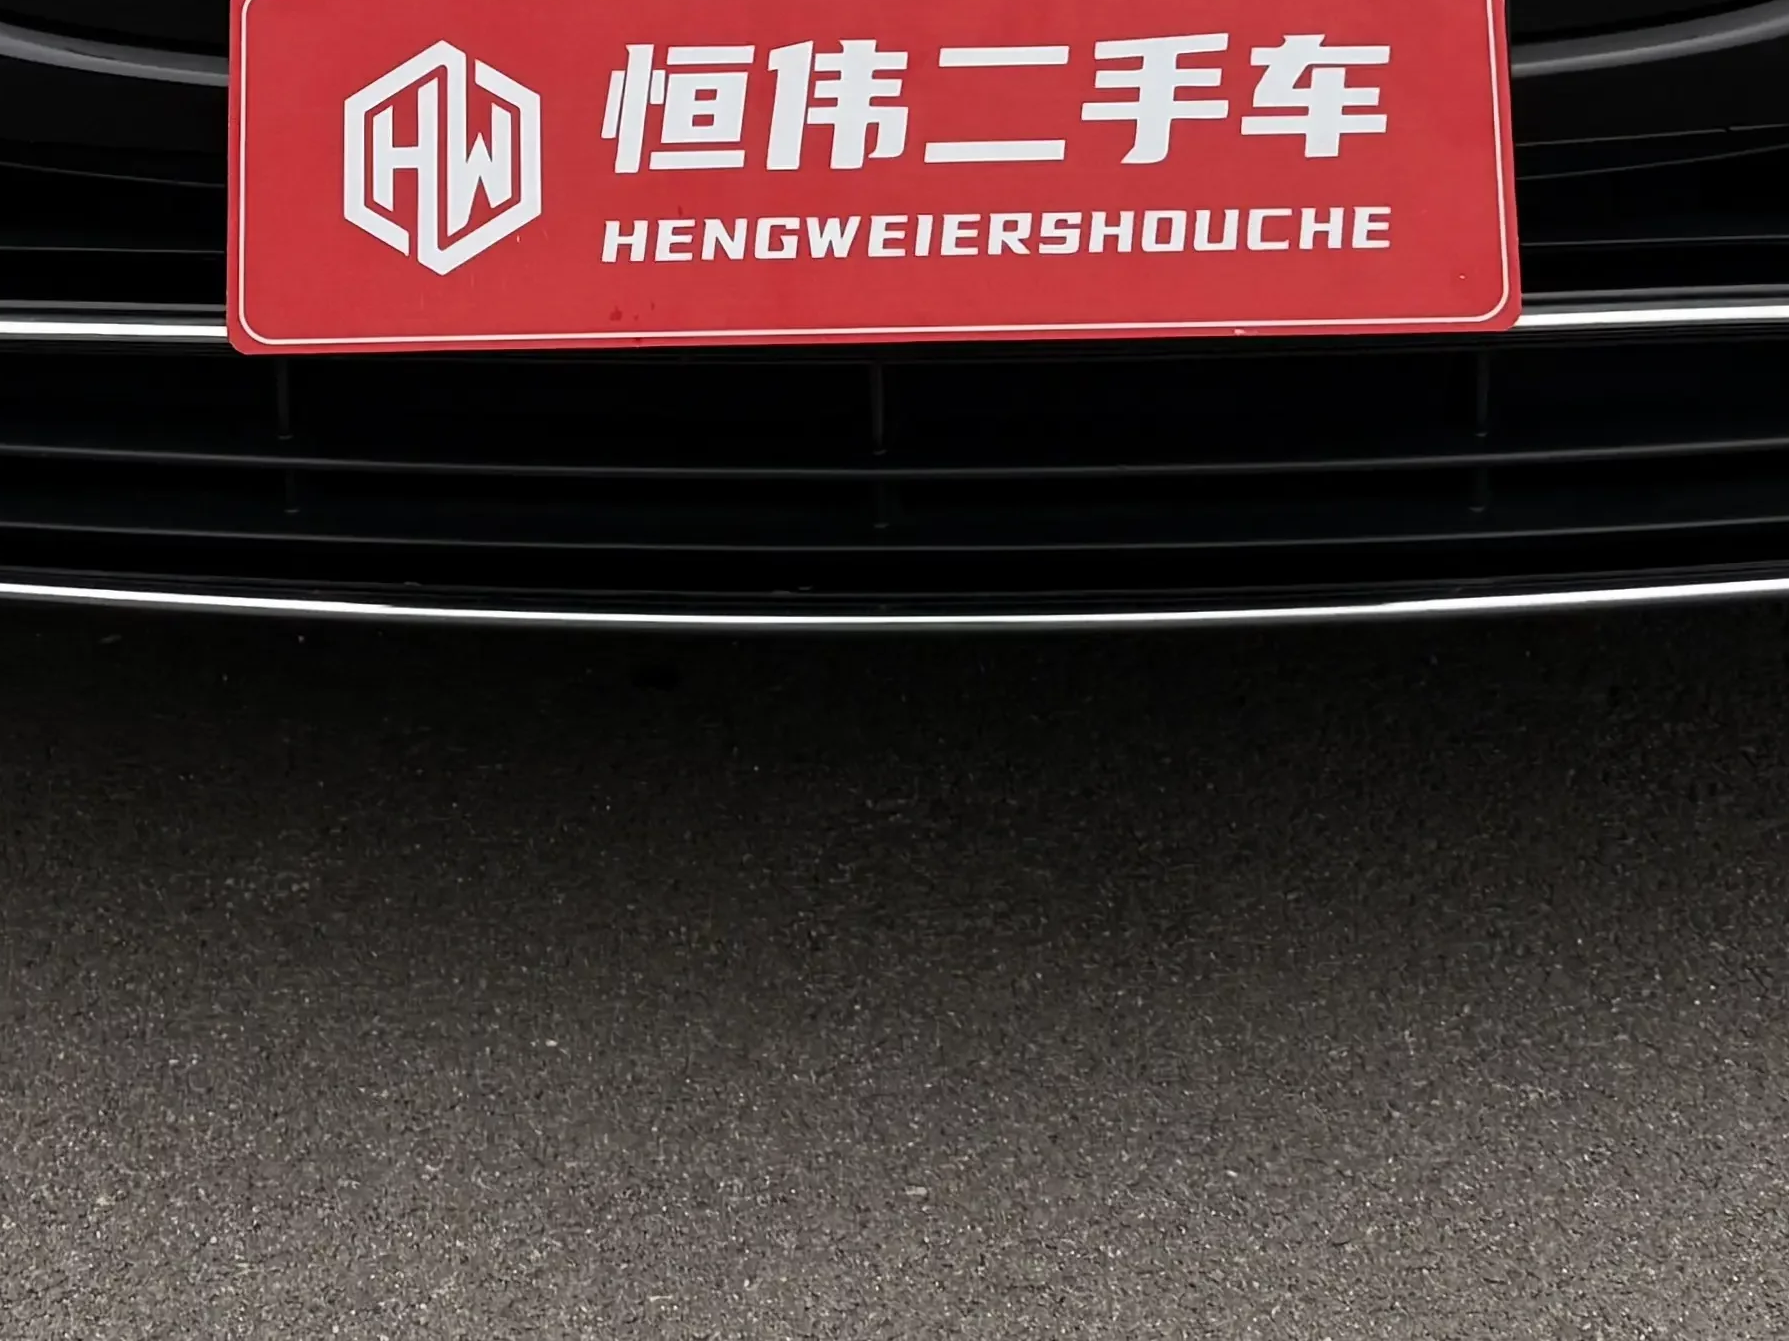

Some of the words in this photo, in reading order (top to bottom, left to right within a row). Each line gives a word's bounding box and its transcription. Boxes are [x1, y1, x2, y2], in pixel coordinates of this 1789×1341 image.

[373, 40, 512, 276] HW
[600, 32, 1392, 174] 恒伟二手车
[600, 205, 1392, 263] HENGWEIERSHOUCHE
